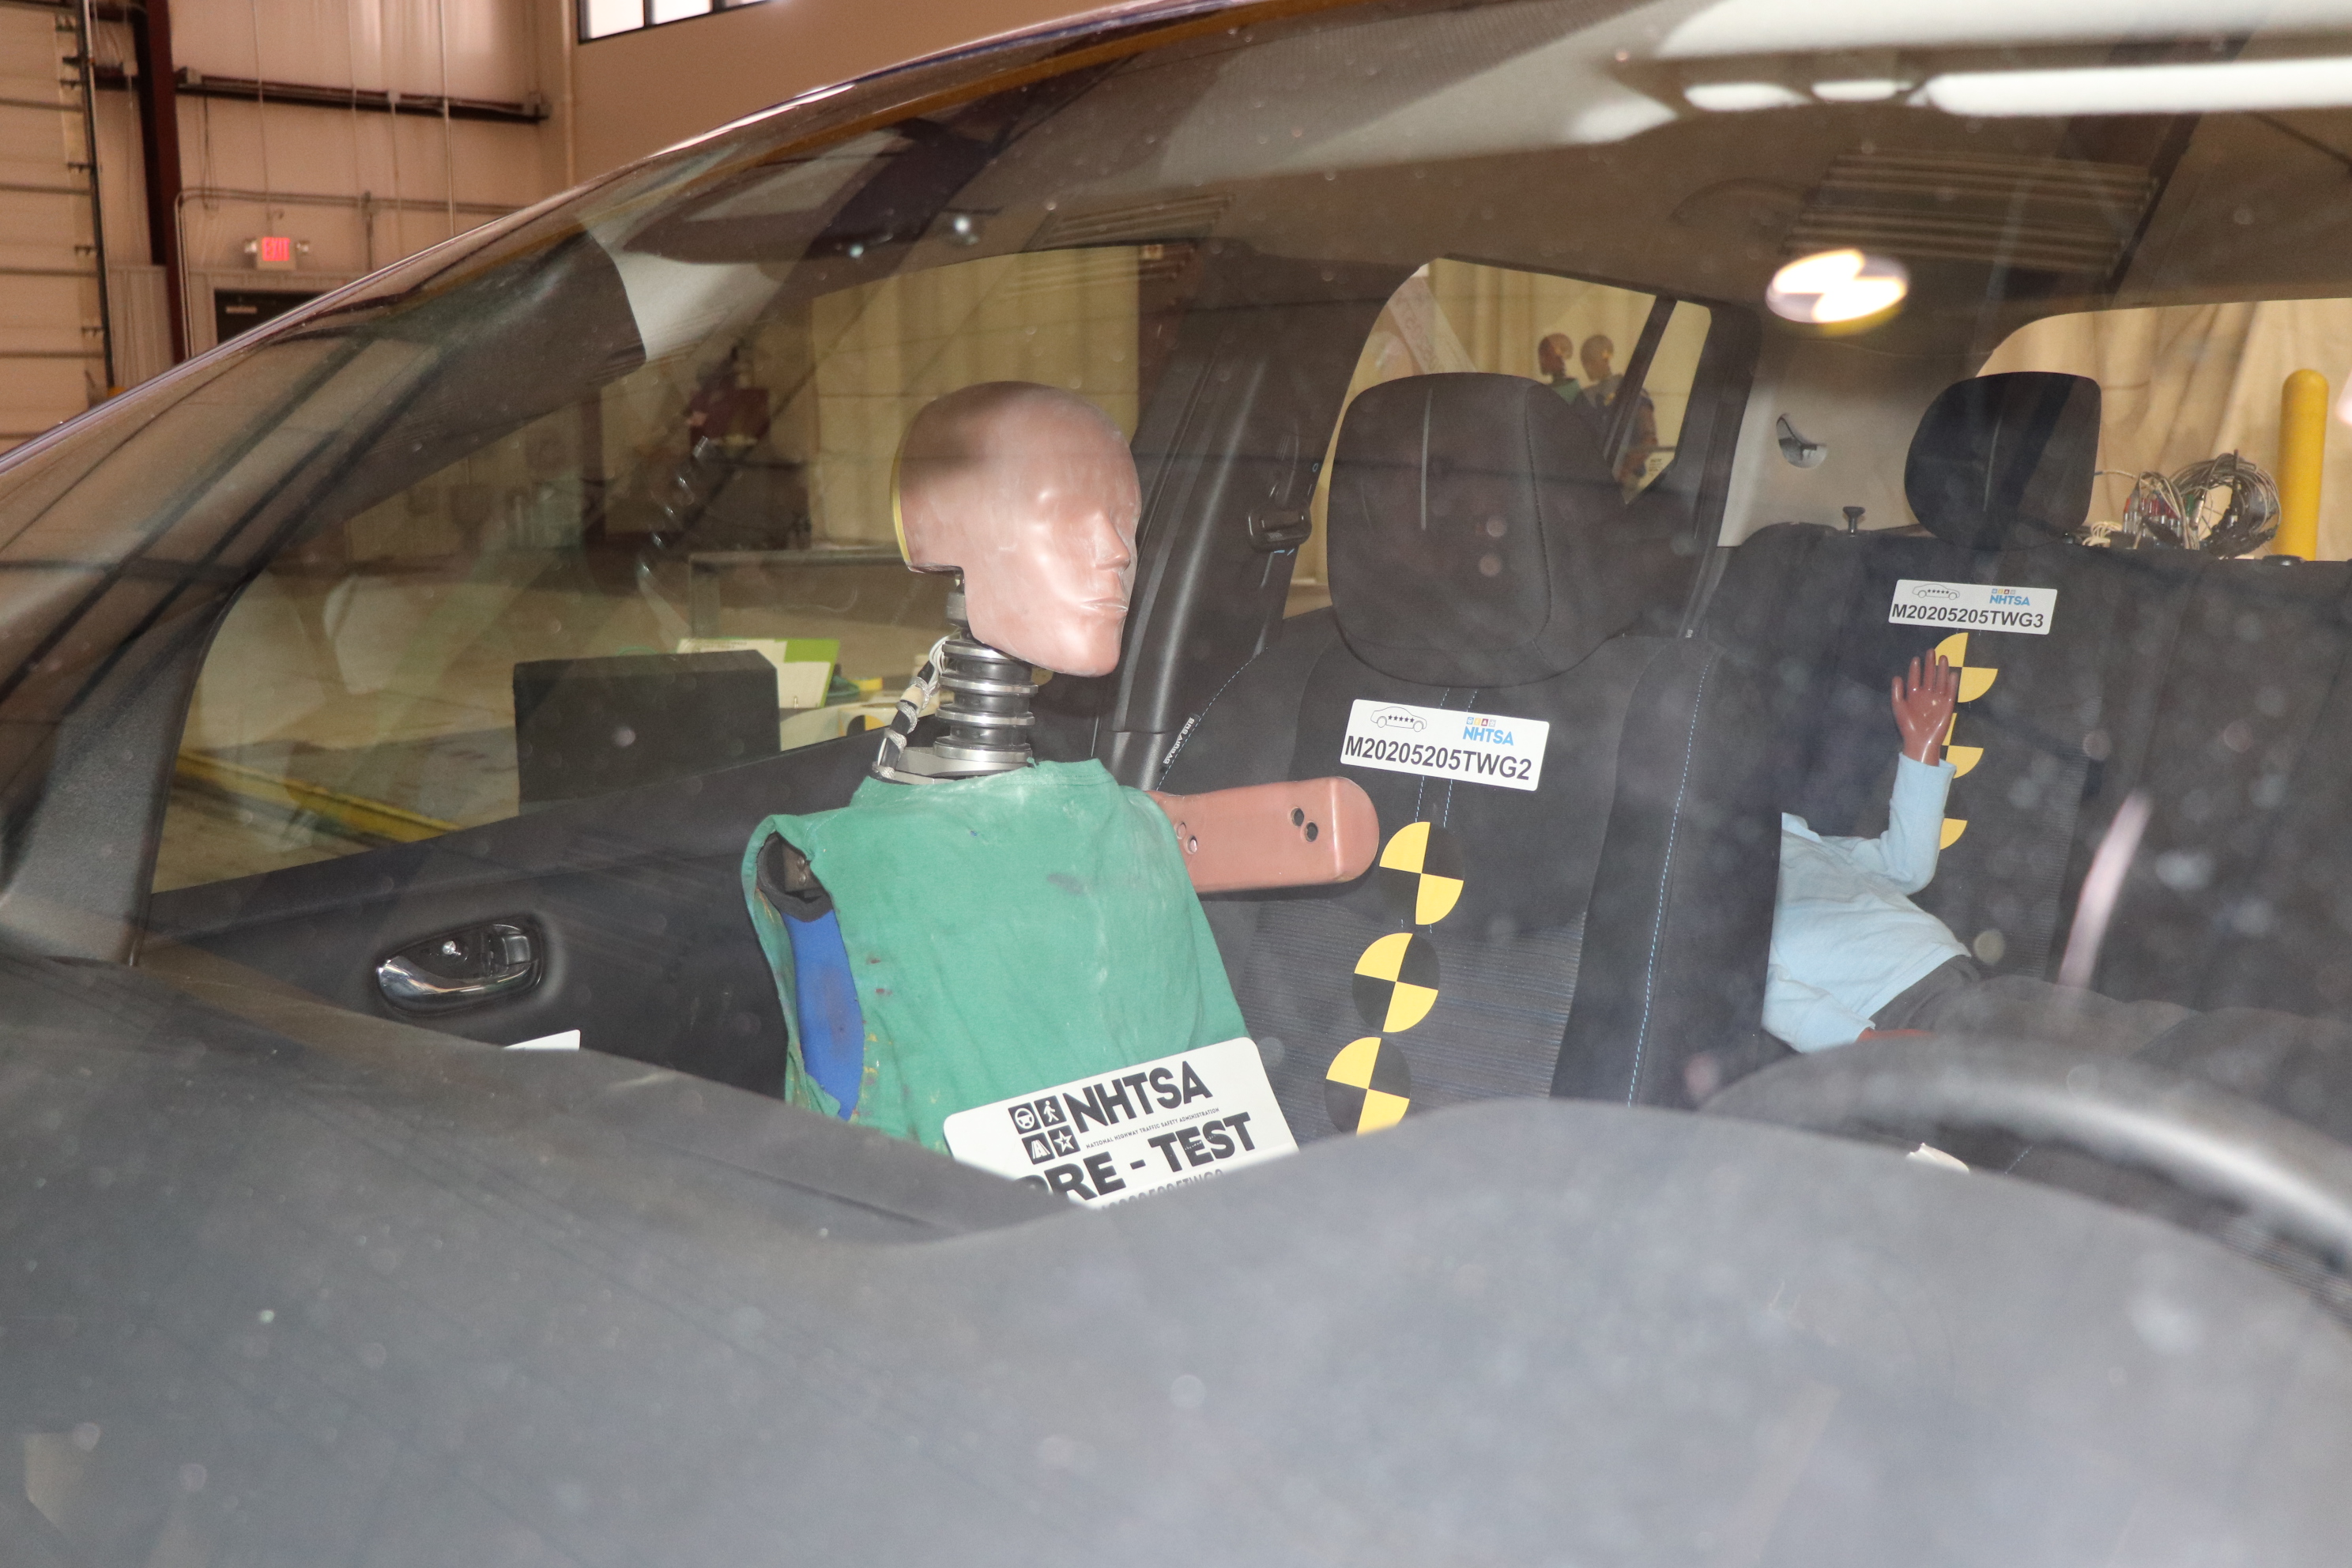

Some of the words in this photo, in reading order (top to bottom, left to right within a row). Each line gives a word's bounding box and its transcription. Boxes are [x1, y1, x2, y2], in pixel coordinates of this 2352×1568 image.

[263, 238, 289, 260] EXIT
[1891, 603, 2044, 628] M20205205TWG3
[1989, 594, 2030, 606] NHTSA
[1462, 726, 1514, 746] NHTSA
[1344, 735, 1532, 781] M20205205TWG2
[1062, 1061, 1213, 1133] NHTSA
[1085, 1137, 1114, 1149] NATIONAL
[1114, 1129, 1139, 1141] HIGHWAY
[1139, 1123, 1160, 1133] TRAFFIC
[1161, 1118, 1178, 1128] SAFETY
[1179, 1107, 1219, 1123] ADMINISTRATION
[1129, 1159, 1146, 1170] -
[1148, 1112, 1255, 1173] TEST
